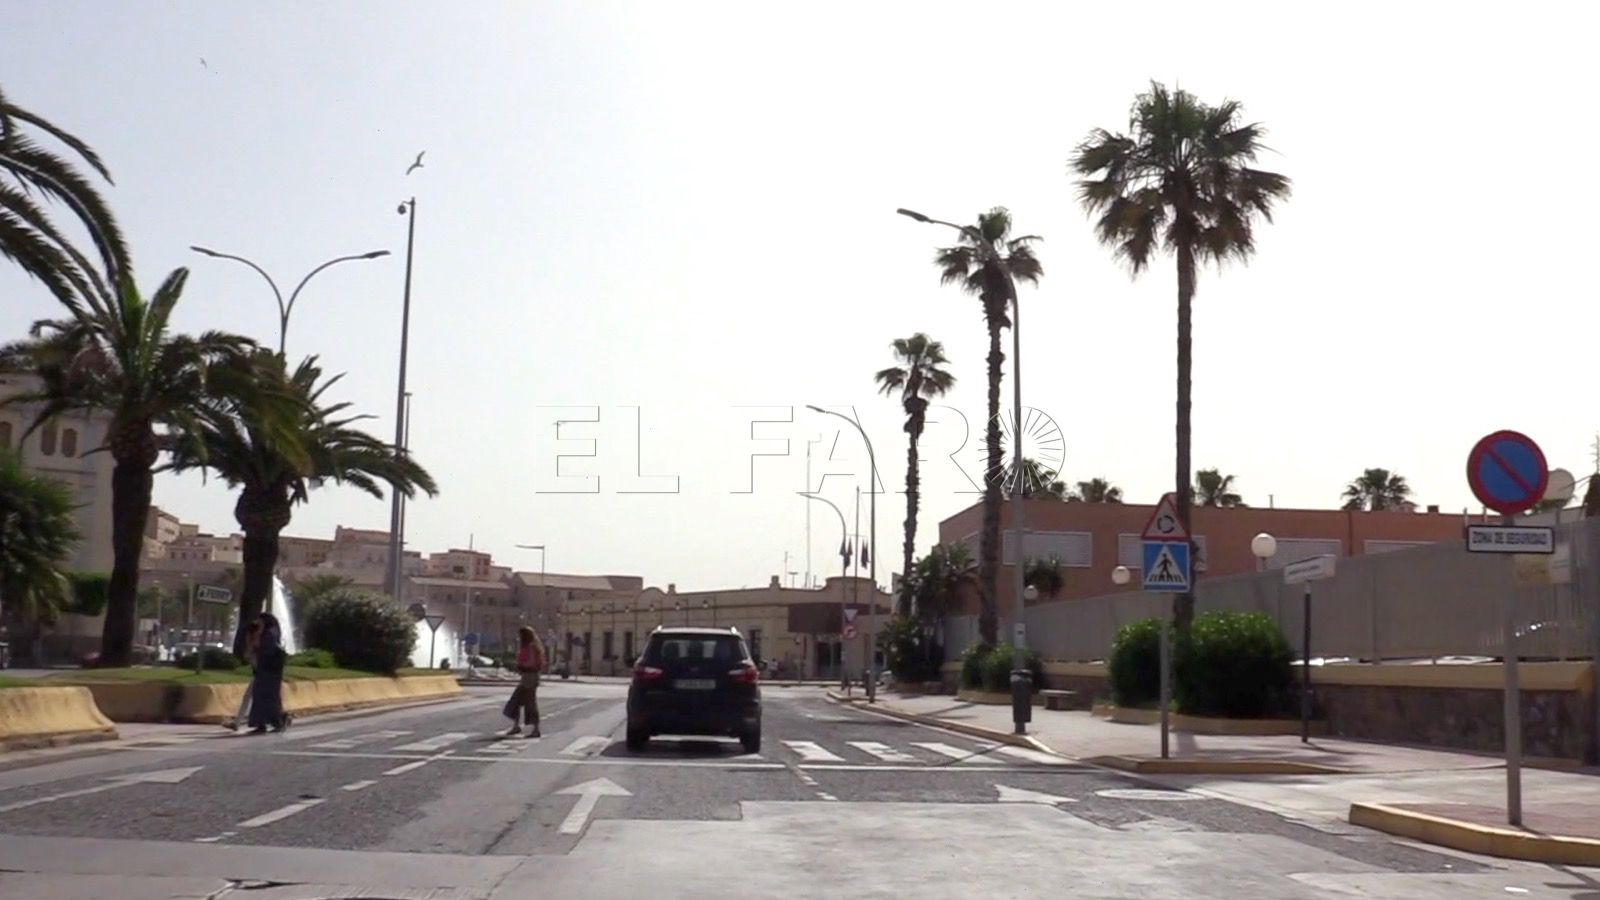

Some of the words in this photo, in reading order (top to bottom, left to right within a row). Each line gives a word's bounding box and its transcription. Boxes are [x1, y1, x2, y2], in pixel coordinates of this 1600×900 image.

[1472, 531, 1493, 544] ZONA
[1494, 531, 1505, 544] DE
[1506, 532, 1547, 545] SEGURIDAD
